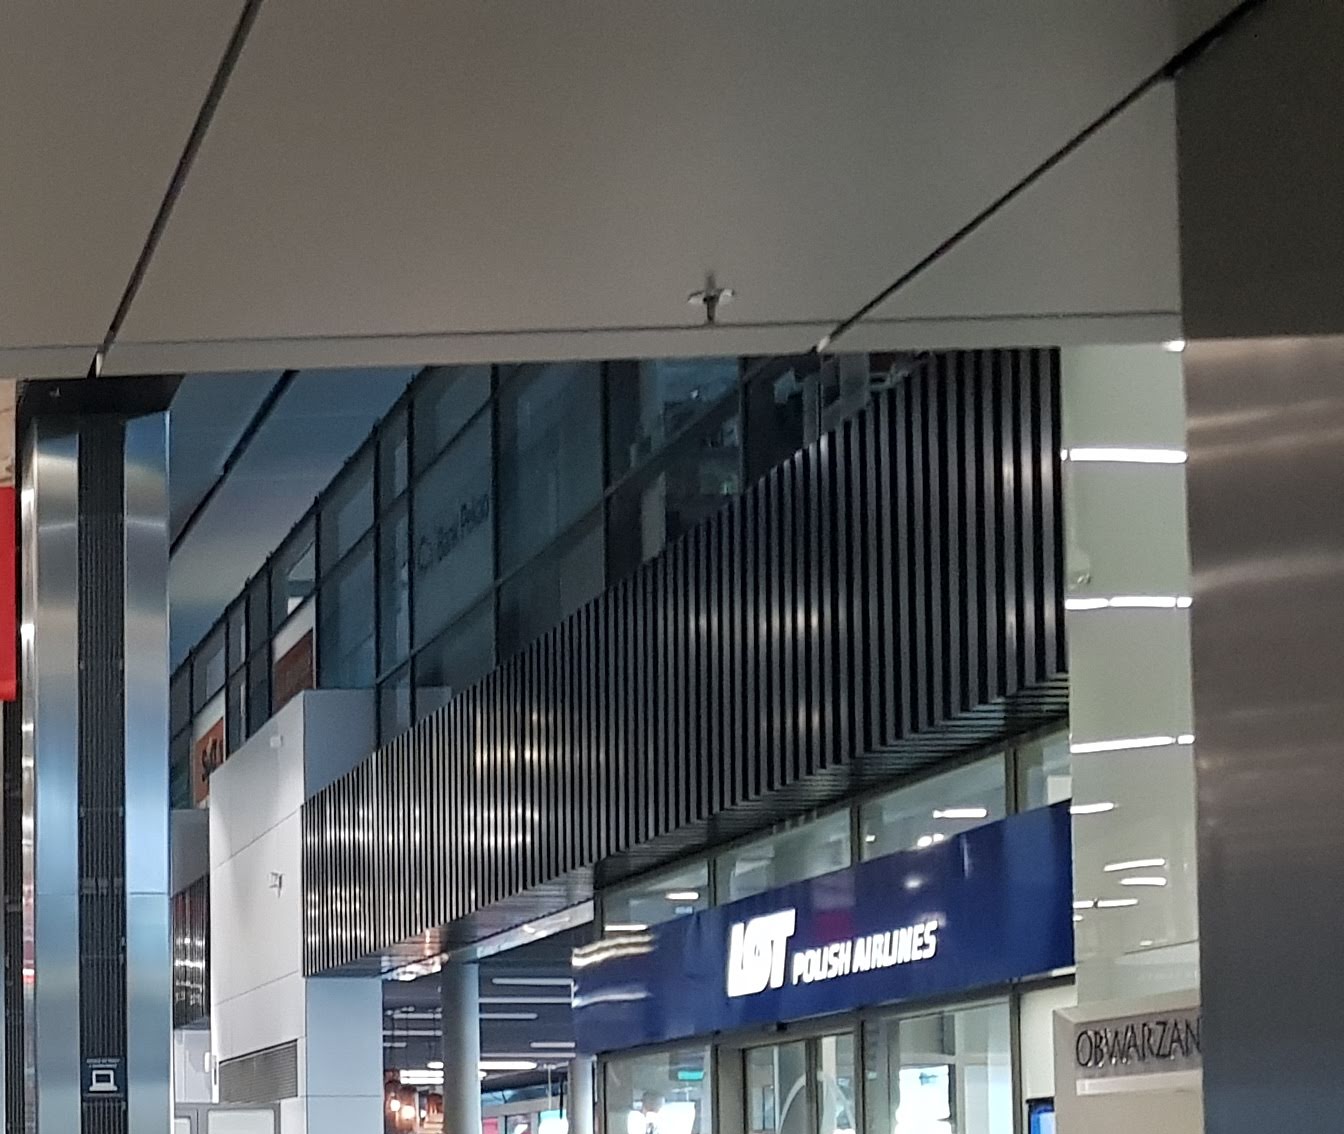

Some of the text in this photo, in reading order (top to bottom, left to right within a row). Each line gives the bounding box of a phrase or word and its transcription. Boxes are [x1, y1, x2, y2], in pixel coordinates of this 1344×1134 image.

[727, 908, 939, 998] LOT POLISH AIRLINES
